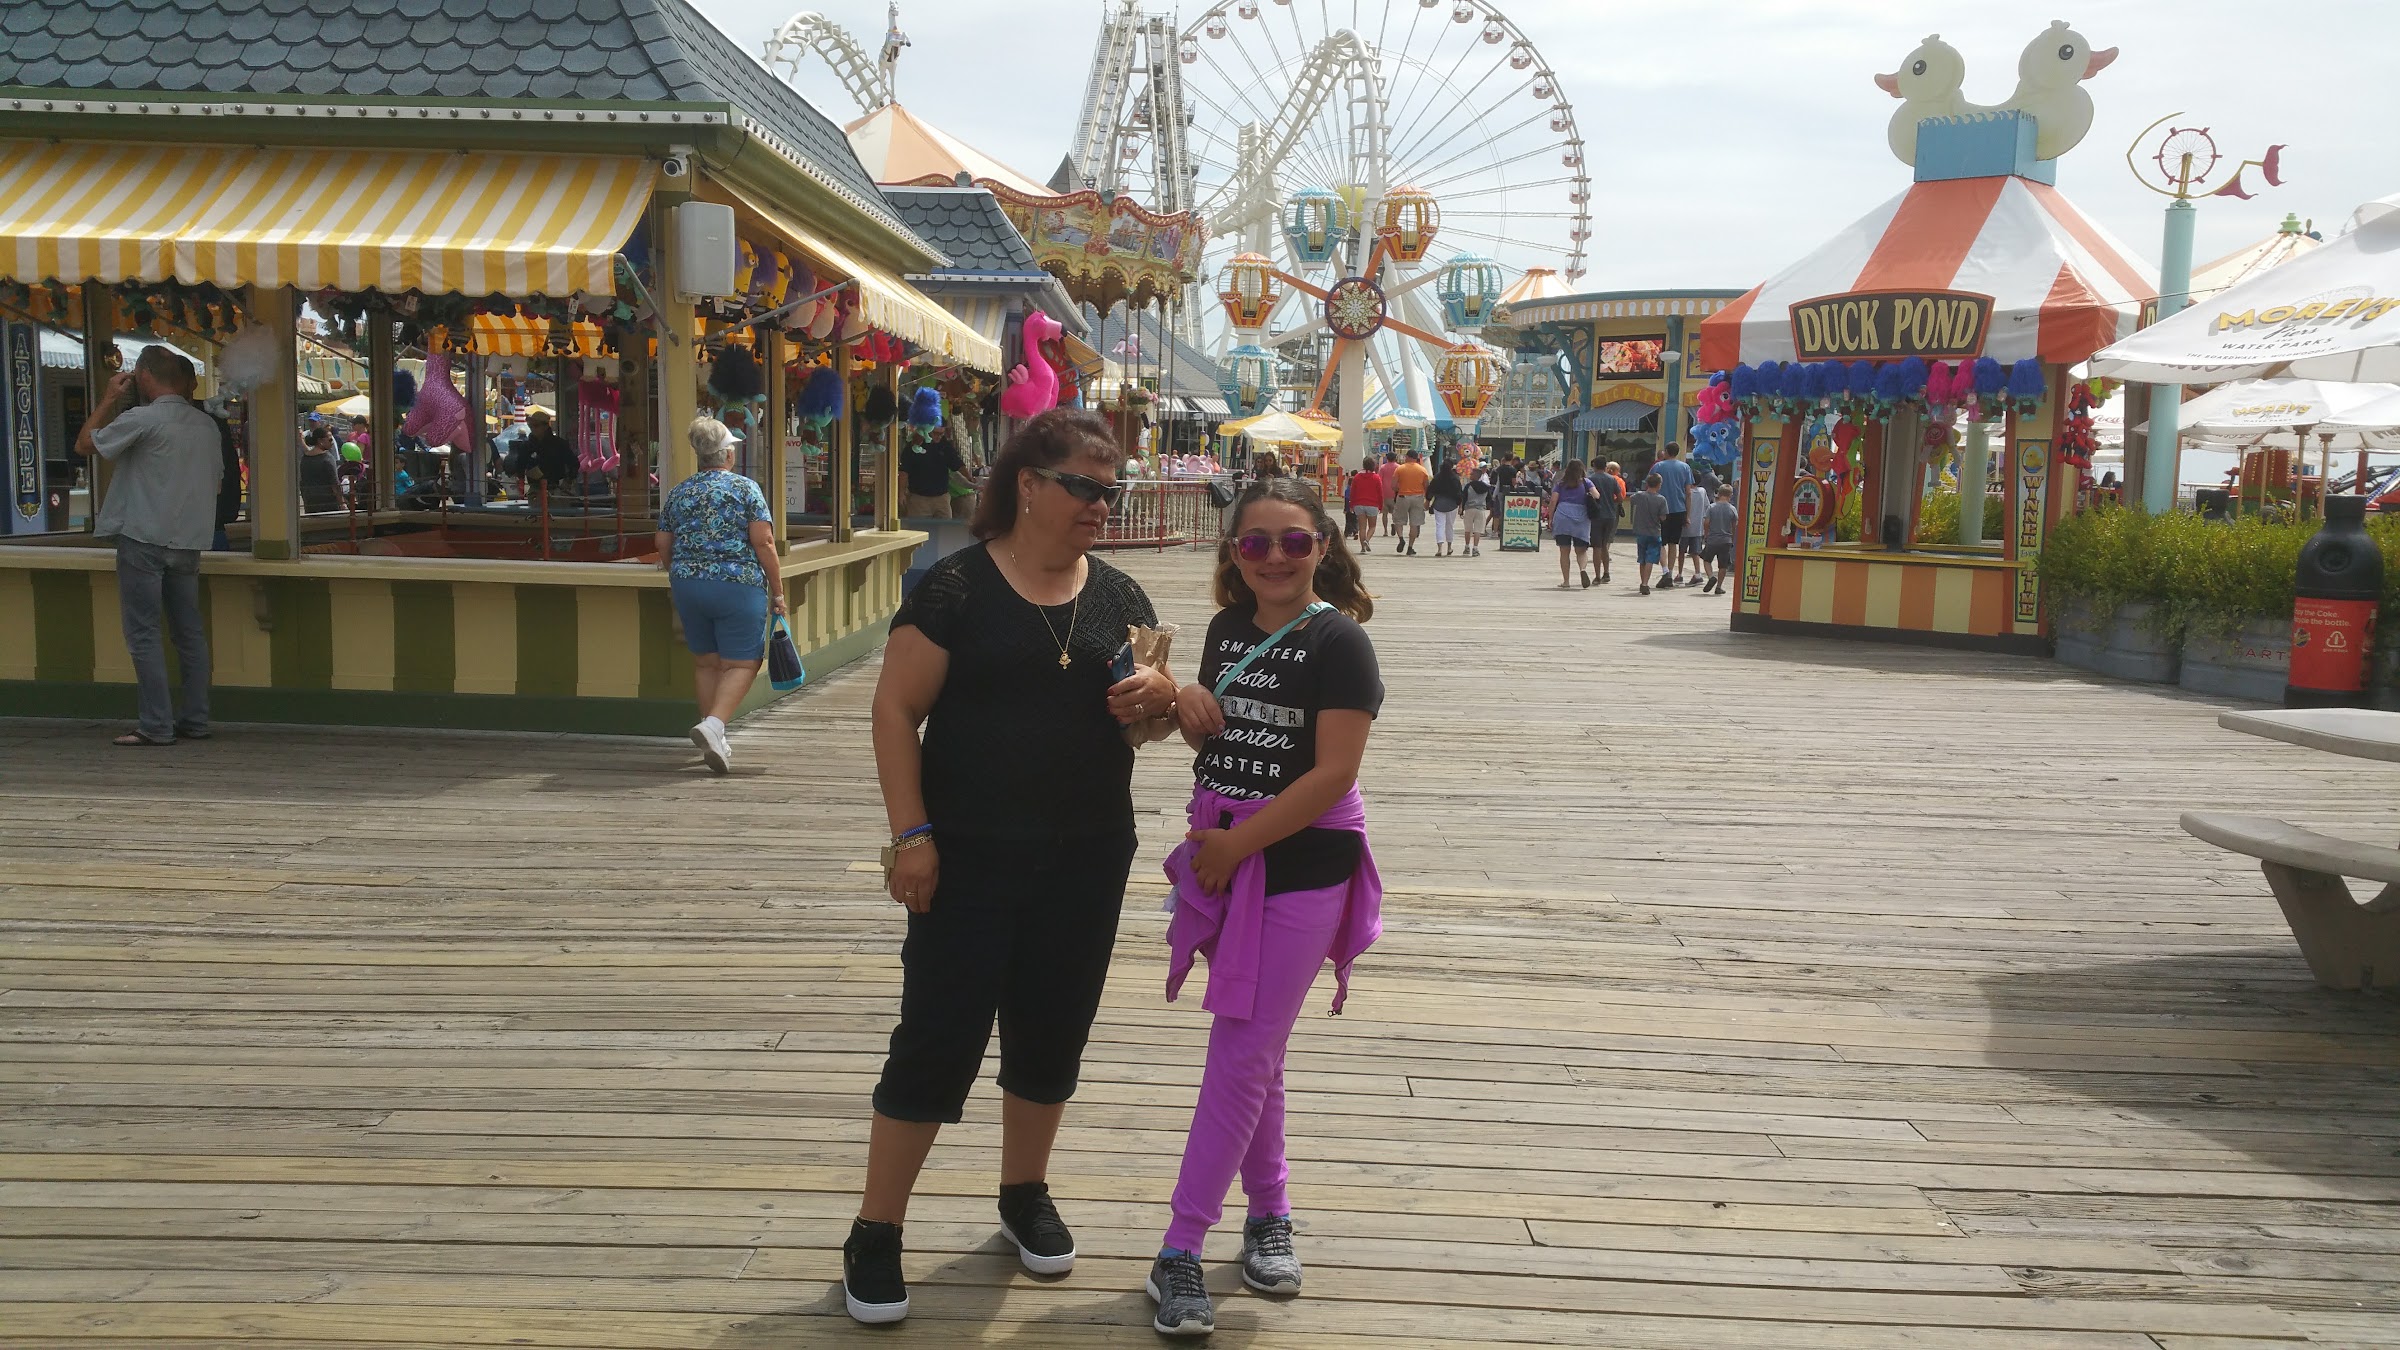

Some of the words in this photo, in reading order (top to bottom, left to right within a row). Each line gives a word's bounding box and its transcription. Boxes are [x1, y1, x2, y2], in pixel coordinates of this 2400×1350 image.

[1799, 299, 1880, 353] DUCK
[1891, 297, 1979, 350] POND
[2280, 336, 2335, 349] PARKS
[1595, 385, 1659, 405] TICKETS
[15, 333, 36, 493] ARCADE
[1507, 498, 1538, 509] MORE
[1752, 471, 1771, 536] WINNER
[2021, 476, 2044, 547] WINNER
[1747, 556, 1761, 597] TIME
[2019, 571, 2037, 616] TIME
[2317, 610, 2340, 618] Coke.
[2325, 619, 2351, 627] bottle.
[1220, 640, 1307, 663] SMARTER
[1216, 662, 1281, 689] Faster
[1208, 727, 1295, 750] marter
[1205, 753, 1282, 778] FASTER
